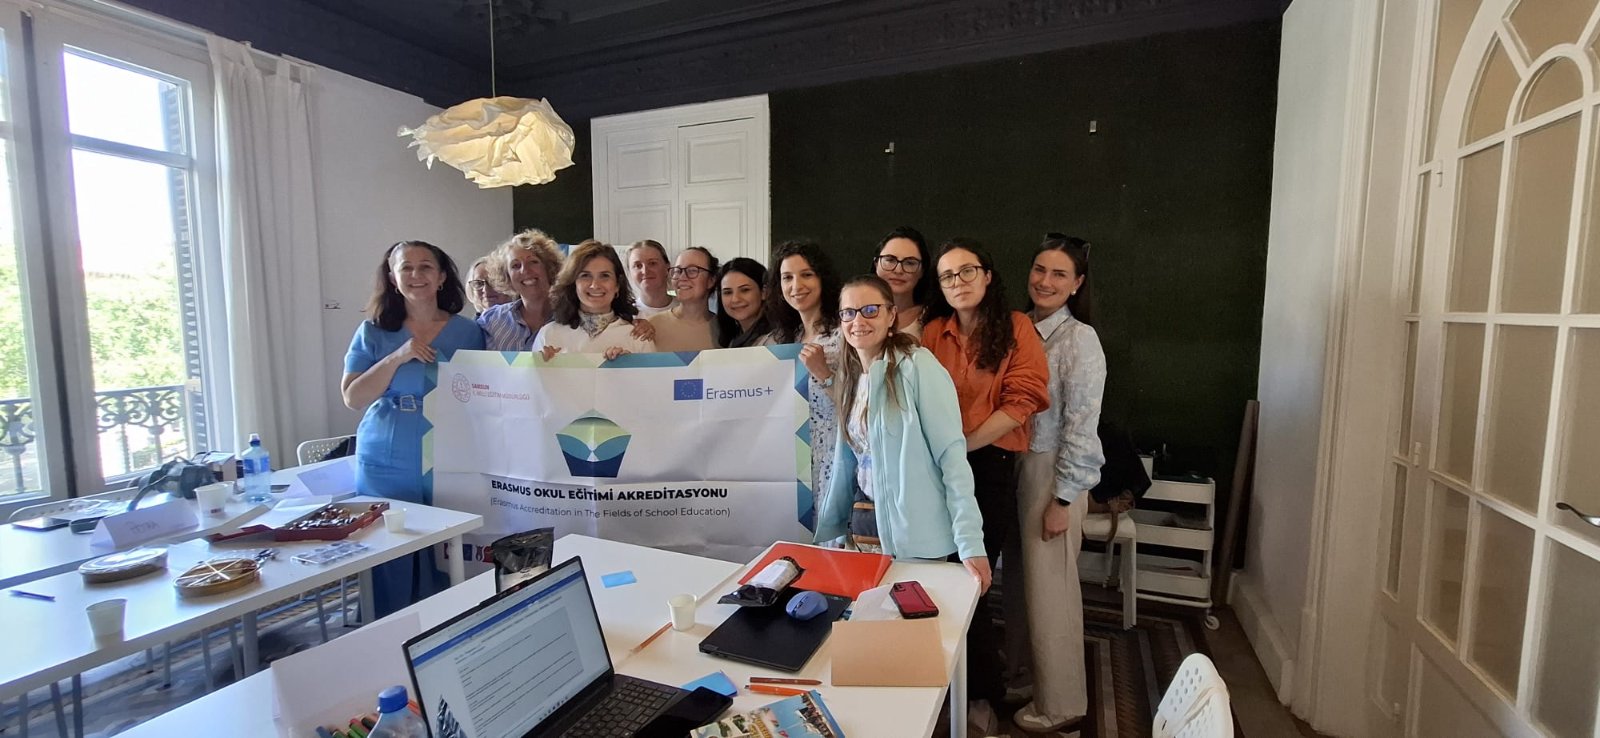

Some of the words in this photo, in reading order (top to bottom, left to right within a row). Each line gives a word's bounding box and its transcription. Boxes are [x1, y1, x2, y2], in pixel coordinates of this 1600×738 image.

[706, 386, 774, 400] Erasmus+
[491, 480, 531, 496] ERASMUS
[534, 488, 565, 499] OKUL
[568, 488, 613, 501] EĞİTİMİ
[617, 486, 728, 500] AKREDİTASYONU
[520, 504, 572, 517] Accreditation
[574, 509, 583, 517] in
[585, 509, 600, 519] The
[603, 509, 632, 518] Fields
[633, 508, 643, 517] of
[645, 508, 678, 517] School
[680, 507, 731, 517] Education)
